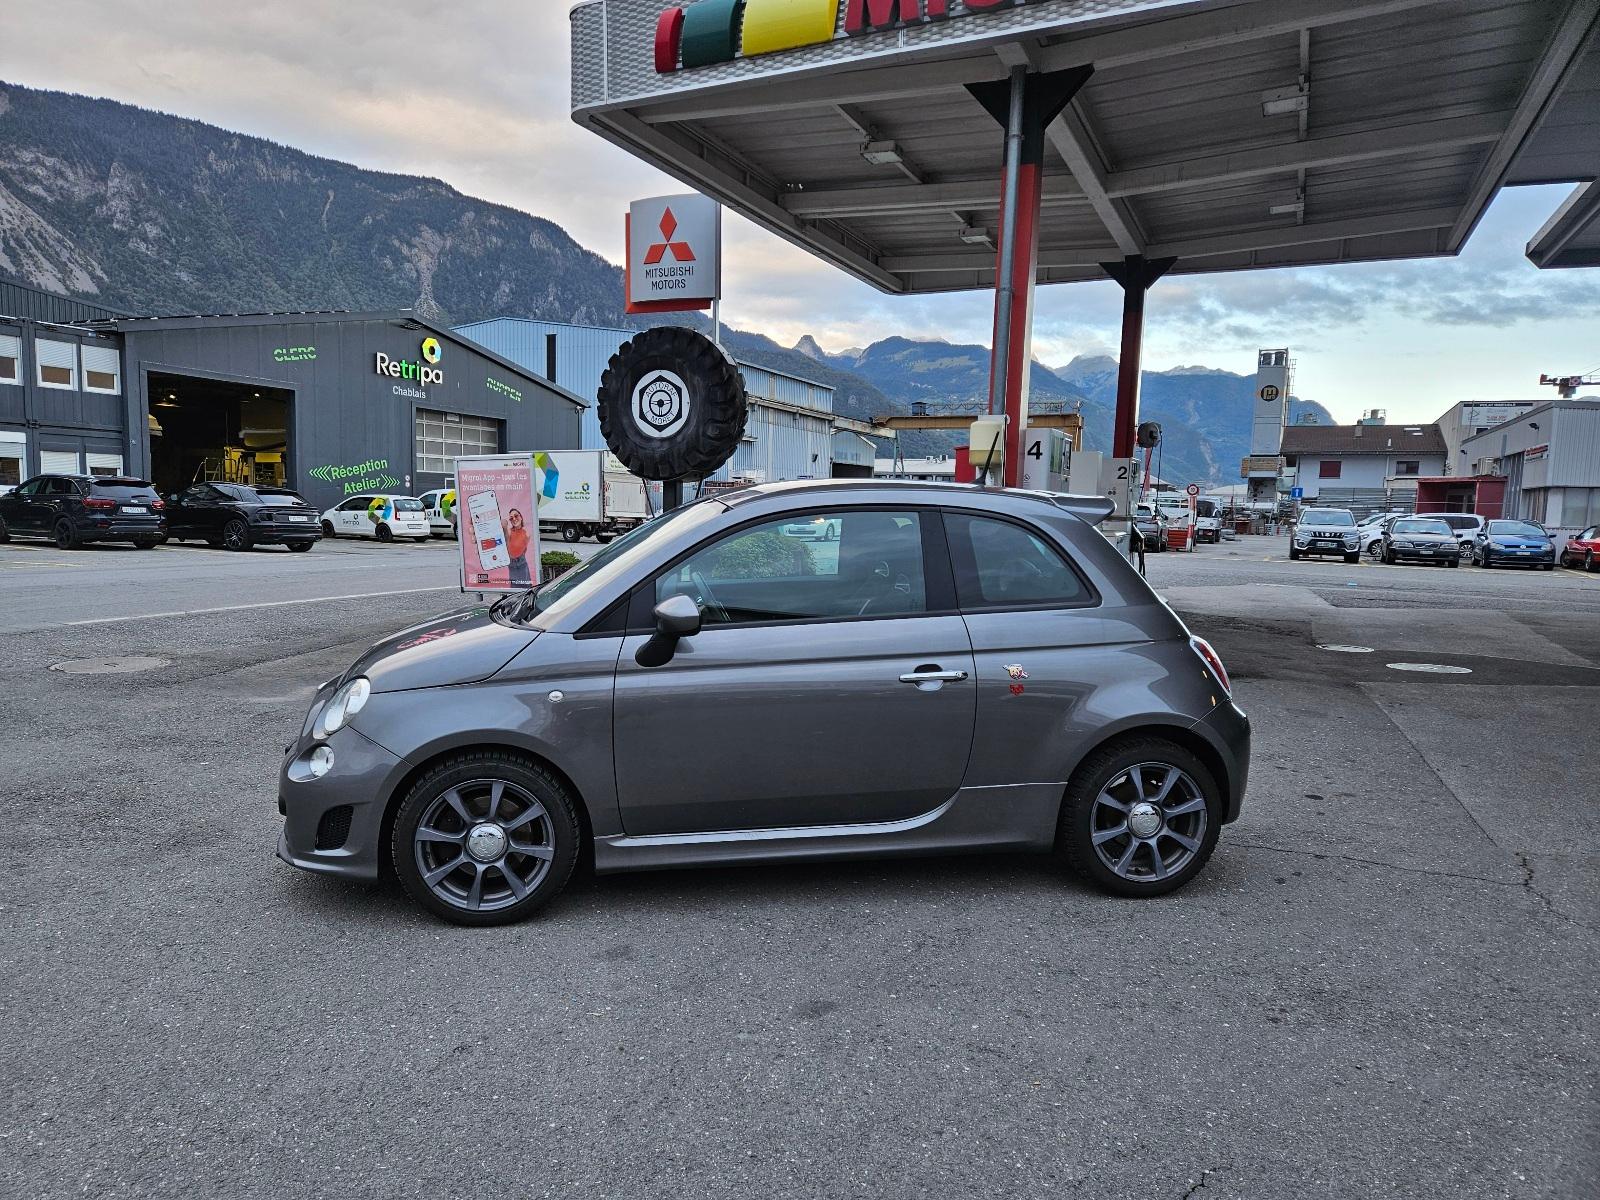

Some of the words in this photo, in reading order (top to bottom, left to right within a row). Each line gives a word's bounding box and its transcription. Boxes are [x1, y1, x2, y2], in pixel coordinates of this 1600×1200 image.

[645, 265, 694, 279] MITSUBISHI
[651, 278, 686, 291] MOTORS
[273, 346, 317, 362] CLERC
[376, 351, 443, 387] Retripa
[392, 385, 426, 399] Chablais
[1027, 440, 1043, 460] 4
[330, 459, 388, 480] Réception
[1117, 466, 1128, 480] 2
[343, 477, 381, 495] Atelier
